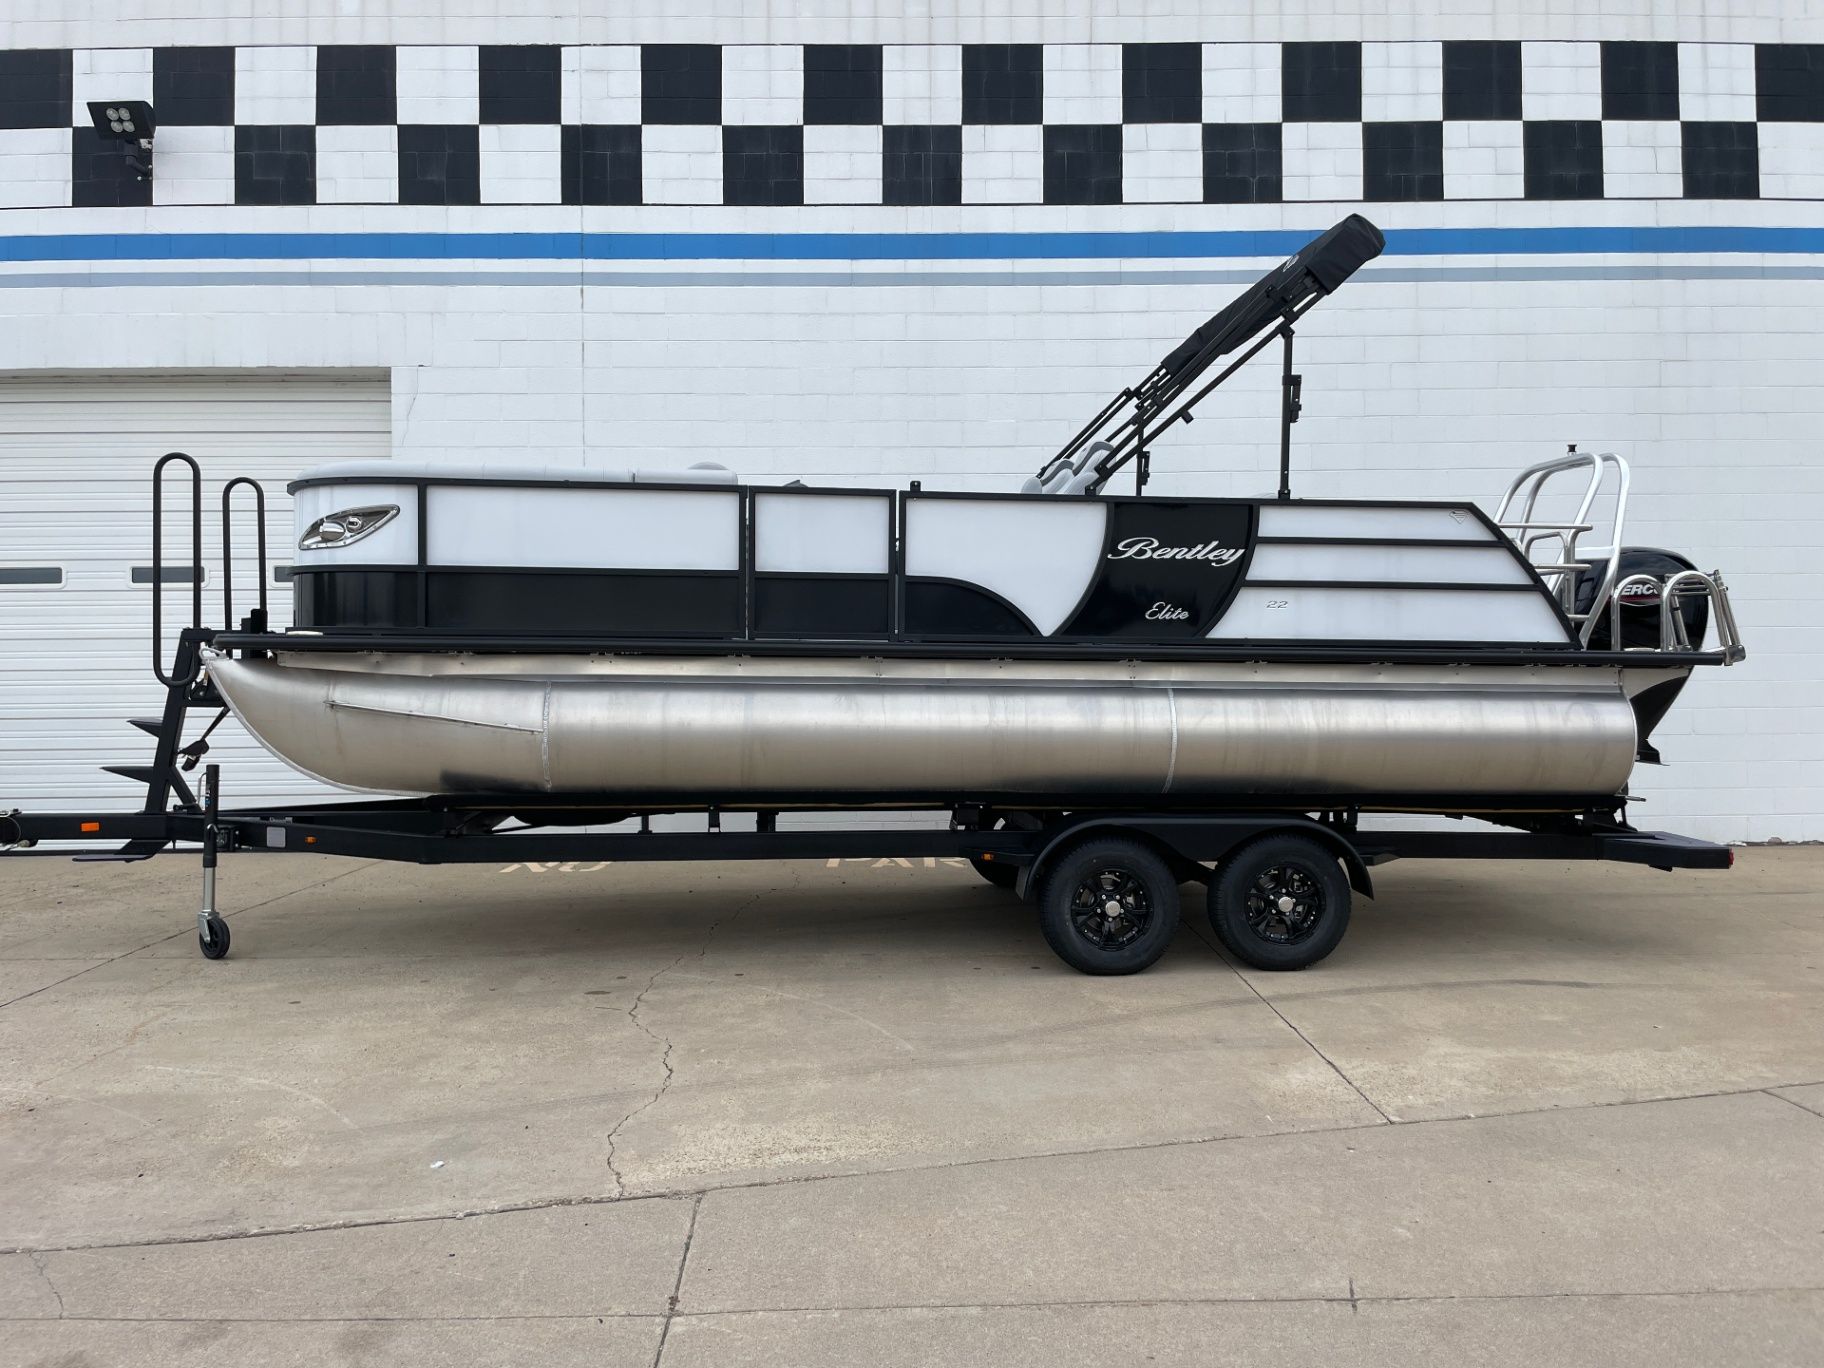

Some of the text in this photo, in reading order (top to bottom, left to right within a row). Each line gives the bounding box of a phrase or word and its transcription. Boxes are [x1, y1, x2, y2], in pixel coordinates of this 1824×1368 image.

[1108, 537, 1245, 566] Bentley
[1613, 583, 1658, 595] ERC
[1145, 602, 1189, 620] Elite
[1266, 600, 1288, 609] 22
